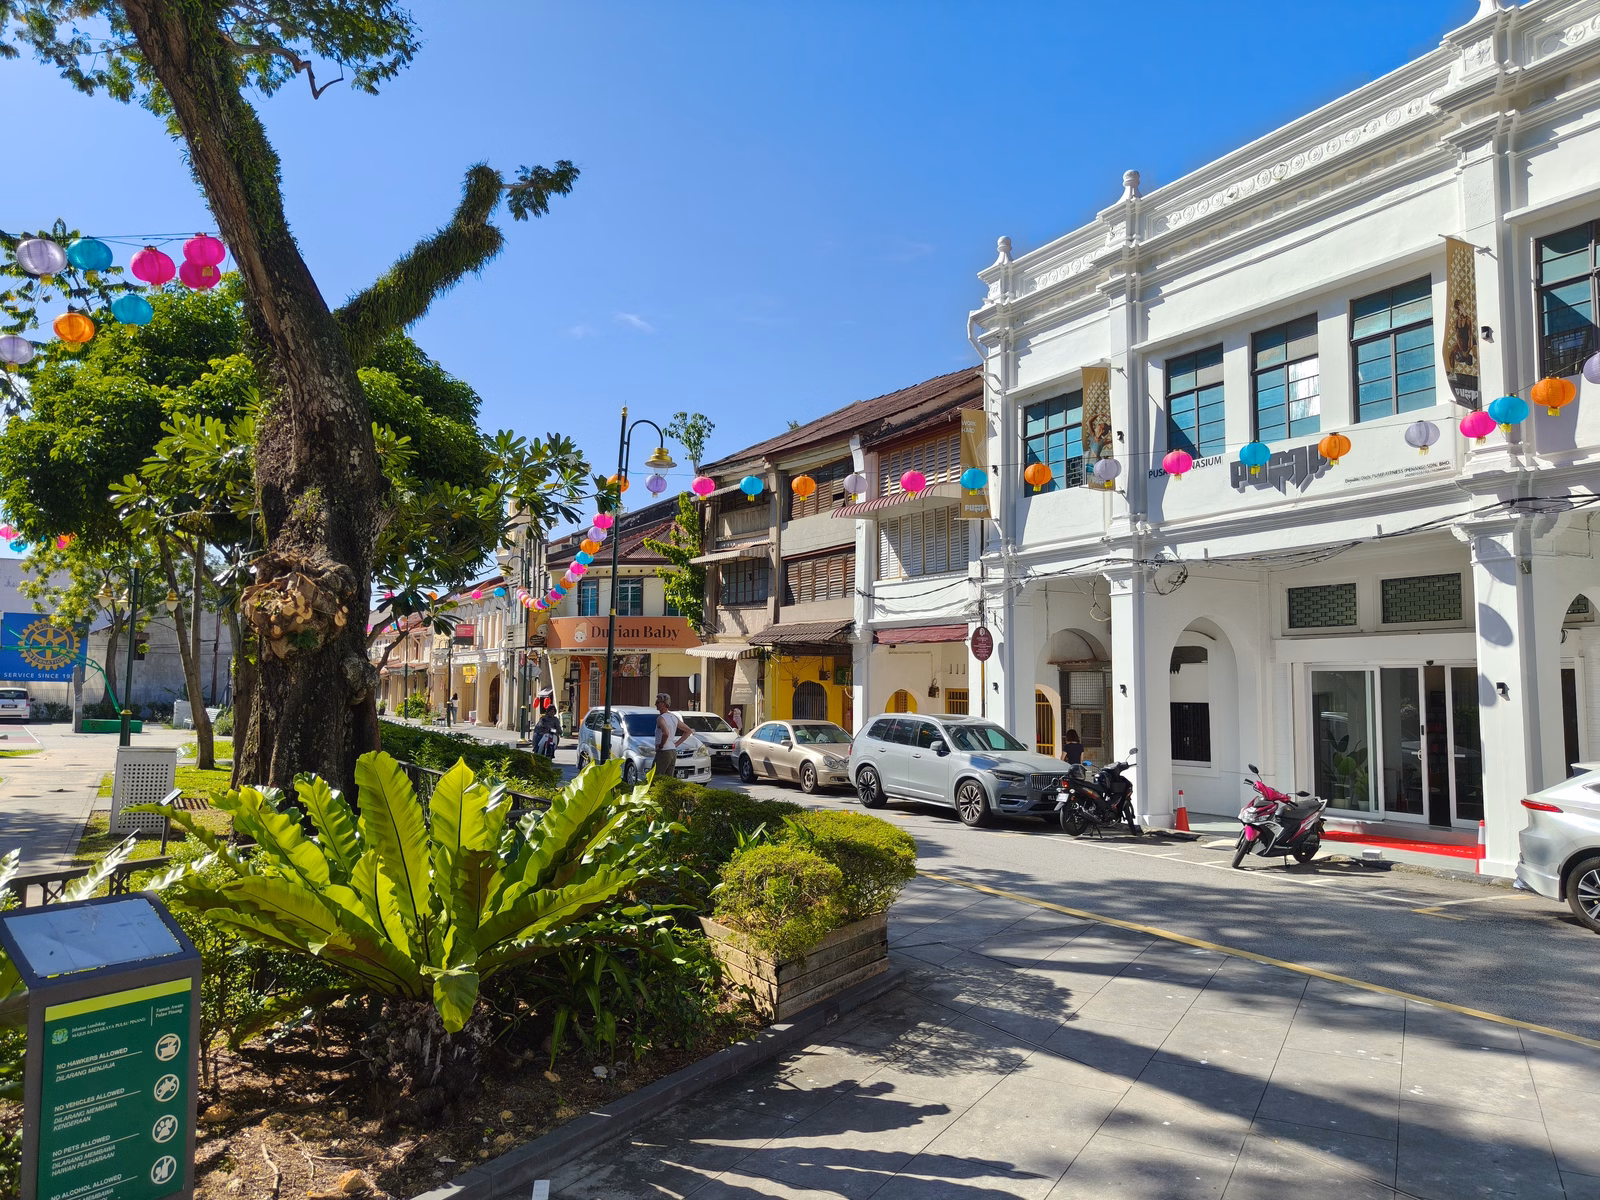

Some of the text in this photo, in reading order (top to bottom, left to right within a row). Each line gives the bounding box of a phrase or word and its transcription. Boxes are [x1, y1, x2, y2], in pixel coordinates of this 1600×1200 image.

[1148, 455, 1222, 479] PUSA NASIUM
[965, 504, 988, 513] PUMP
[643, 625, 680, 641] Baby
[27, 650, 67, 665] INTERNATION
[156, 1005, 170, 1013] Taman
[169, 1008, 182, 1016] Pinang
[72, 1017, 146, 1038] MAJLIS BANDARAYA PULAU PINANG
[87, 1021, 106, 1029] Landskap
[56, 1047, 128, 1070] NO HAWKERS ALLOWED
[55, 1061, 115, 1083] DILARANG MENJAJA
[54, 1088, 125, 1112] NO VEHICLES ALLOWED
[53, 1101, 117, 1124] DILARANG MEMBAWA
[53, 1115, 91, 1131] KENDERAAN
[52, 1135, 110, 1157] NO PETS ALLOWED
[52, 1144, 116, 1169] DILARANG MEMBAWA
[52, 1152, 115, 1177] HAIWAN PELIHARAAN
[61, 1184, 91, 1199] ALCOHOL
[92, 1173, 122, 1188] ALLOWED
